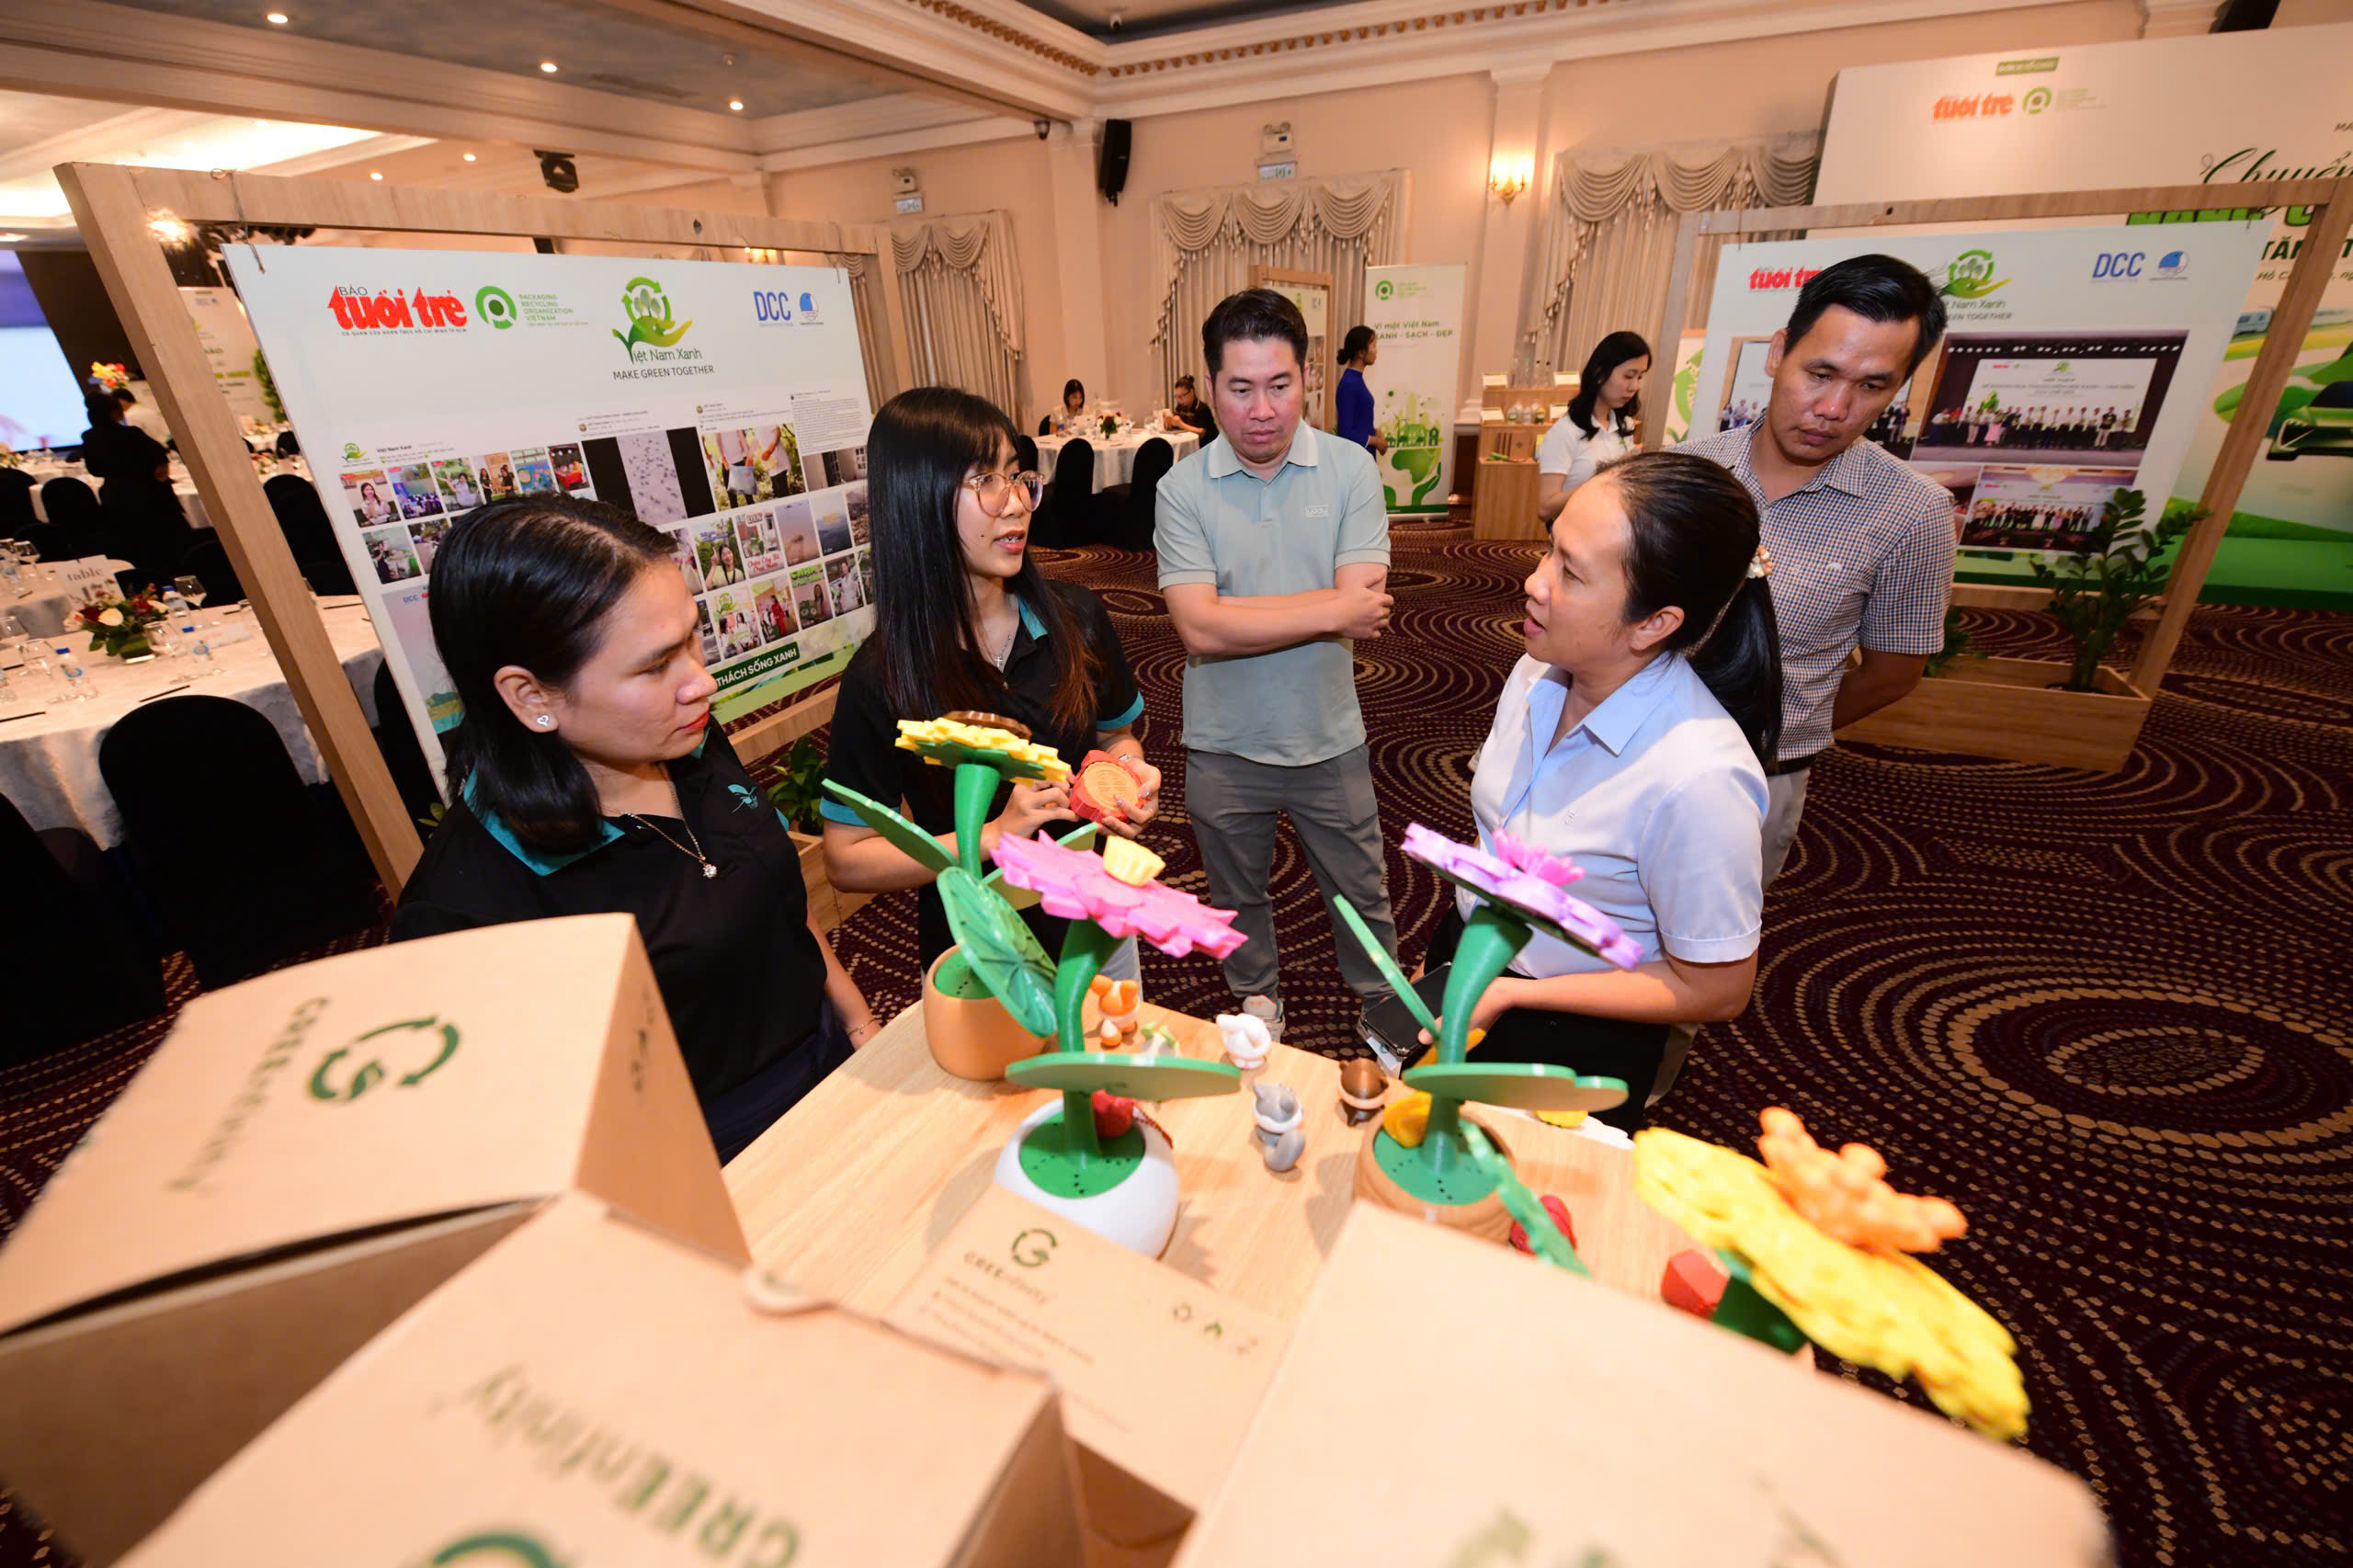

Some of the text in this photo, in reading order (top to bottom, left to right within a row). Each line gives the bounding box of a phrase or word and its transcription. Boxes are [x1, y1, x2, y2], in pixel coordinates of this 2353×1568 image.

[2092, 252, 2146, 278] DCC
[753, 291, 790, 321] DCC
[650, 349, 676, 360] Nam
[676, 348, 702, 360] Xanh
[613, 365, 714, 381] MAKE GREEN TOGETHER
[66, 565, 104, 582] table
[717, 647, 798, 687] THÁCH SỐNG XANH
